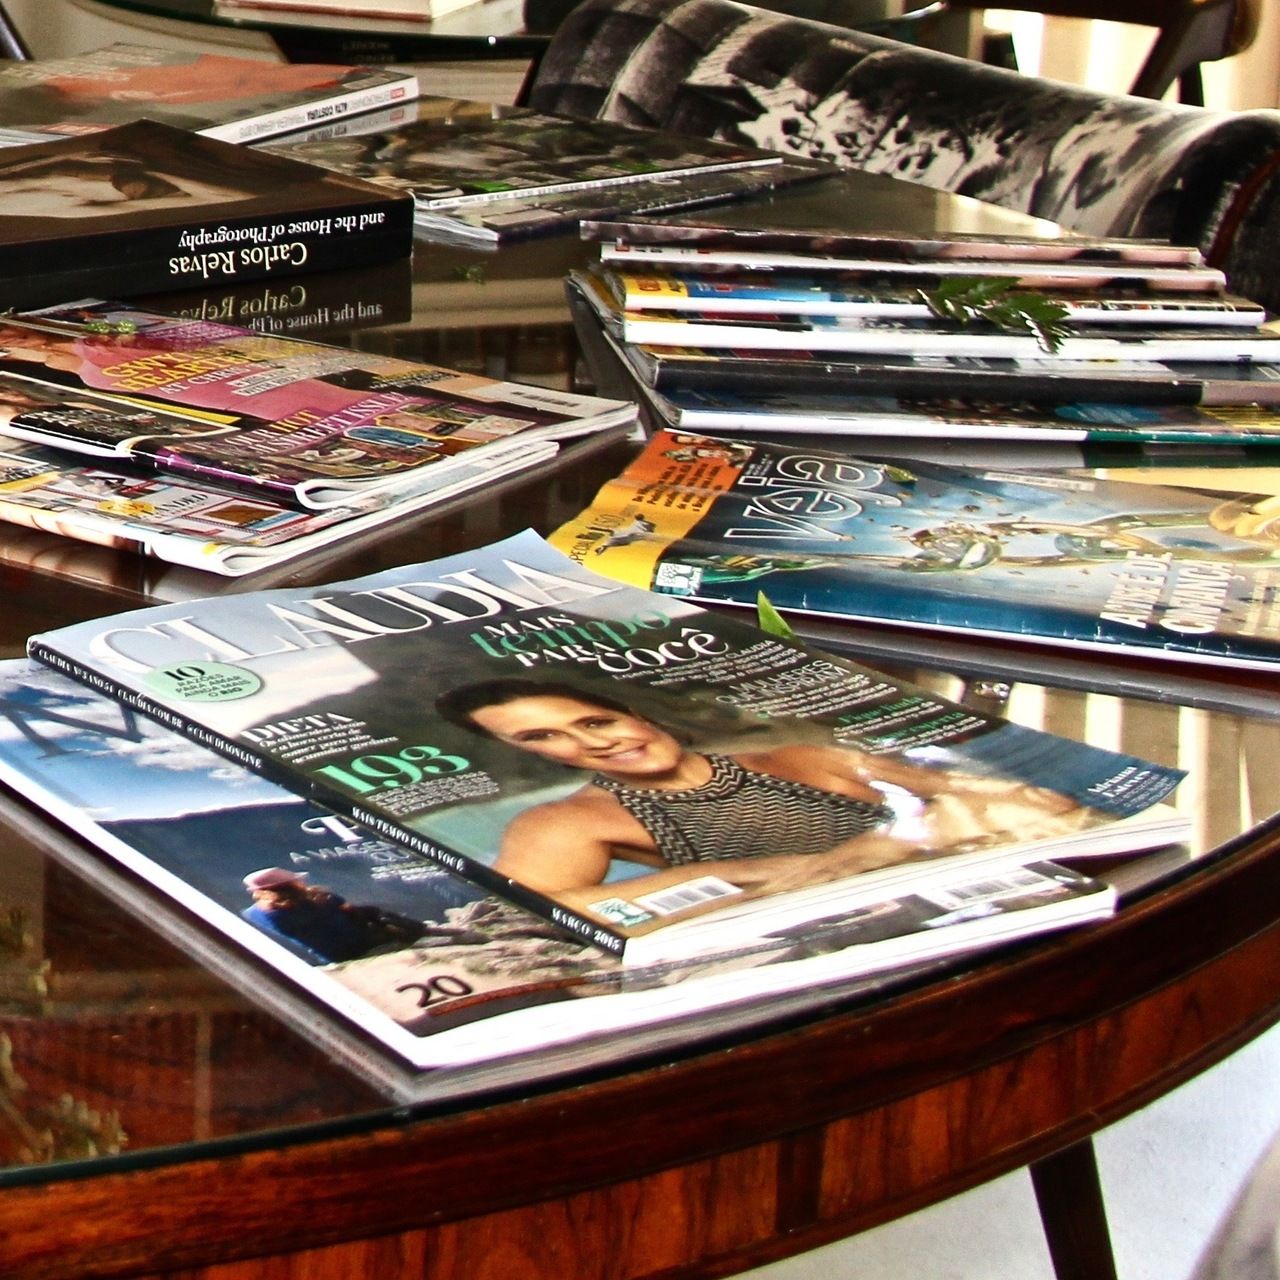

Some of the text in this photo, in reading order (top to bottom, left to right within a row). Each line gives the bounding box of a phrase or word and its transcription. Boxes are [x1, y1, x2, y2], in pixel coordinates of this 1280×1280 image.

[178, 211, 385, 252] and the House of Photography
[169, 241, 308, 278] Carlos Relvas
[87, 558, 626, 673] CLAUDIA
[469, 609, 672, 658] tempo
[483, 613, 576, 640] MAIS
[515, 639, 616, 668] PARA
[577, 627, 730, 673] você
[38, 648, 72, 672] CLAUDIA
[117, 688, 183, 729] CLAUDIA.COM.BR
[175, 675, 242, 694] PARA AMAR
[184, 679, 253, 698] AINDA MAIS
[730, 659, 835, 694] MULHERES
[239, 711, 355, 743] DIETA
[351, 806, 377, 827] MAIS
[376, 819, 410, 844] TEMPO
[409, 835, 437, 858] PARA
[436, 848, 466, 872] VOCÊ
[551, 907, 622, 951] MARÇO 2015
[396, 975, 474, 1008] 20
